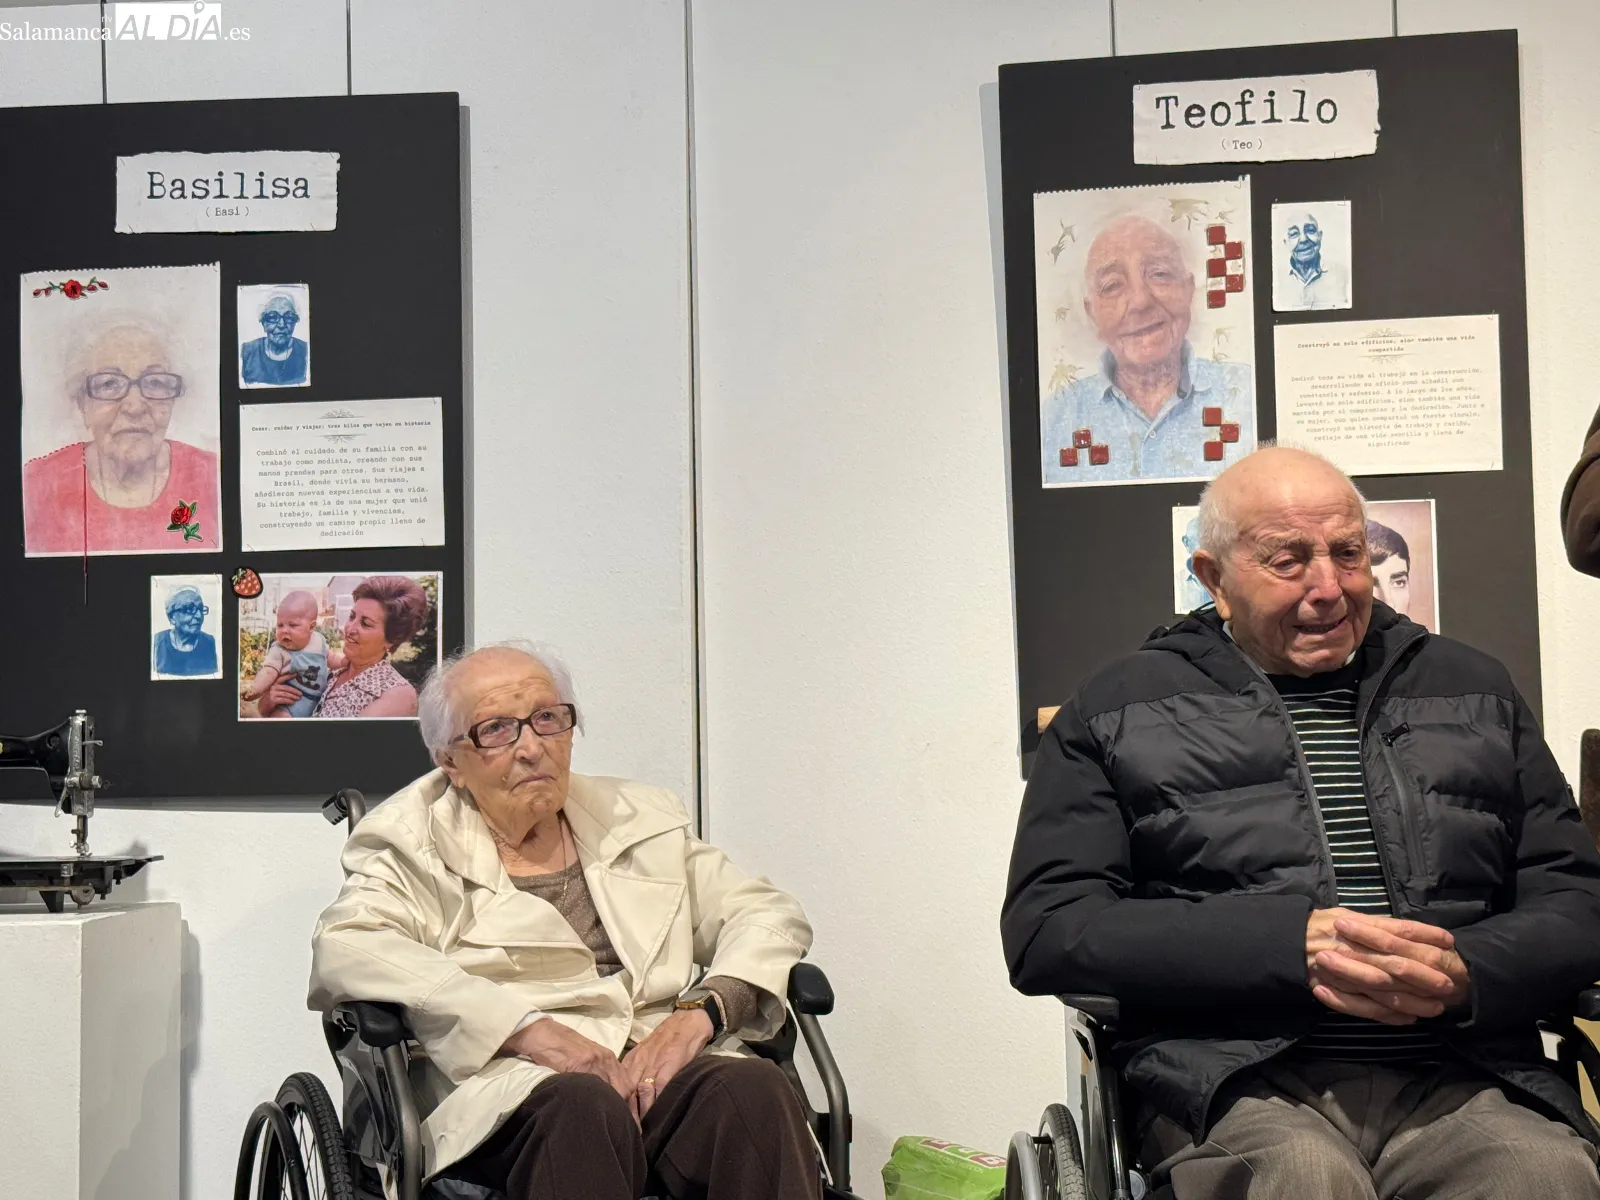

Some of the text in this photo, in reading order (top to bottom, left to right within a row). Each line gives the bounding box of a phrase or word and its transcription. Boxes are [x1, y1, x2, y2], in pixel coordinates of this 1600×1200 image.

[1156, 89, 1338, 130] Teofilo
[1232, 140, 1252, 150] Teo
[147, 171, 310, 199] Basilisa
[215, 206, 239, 216] Basi
